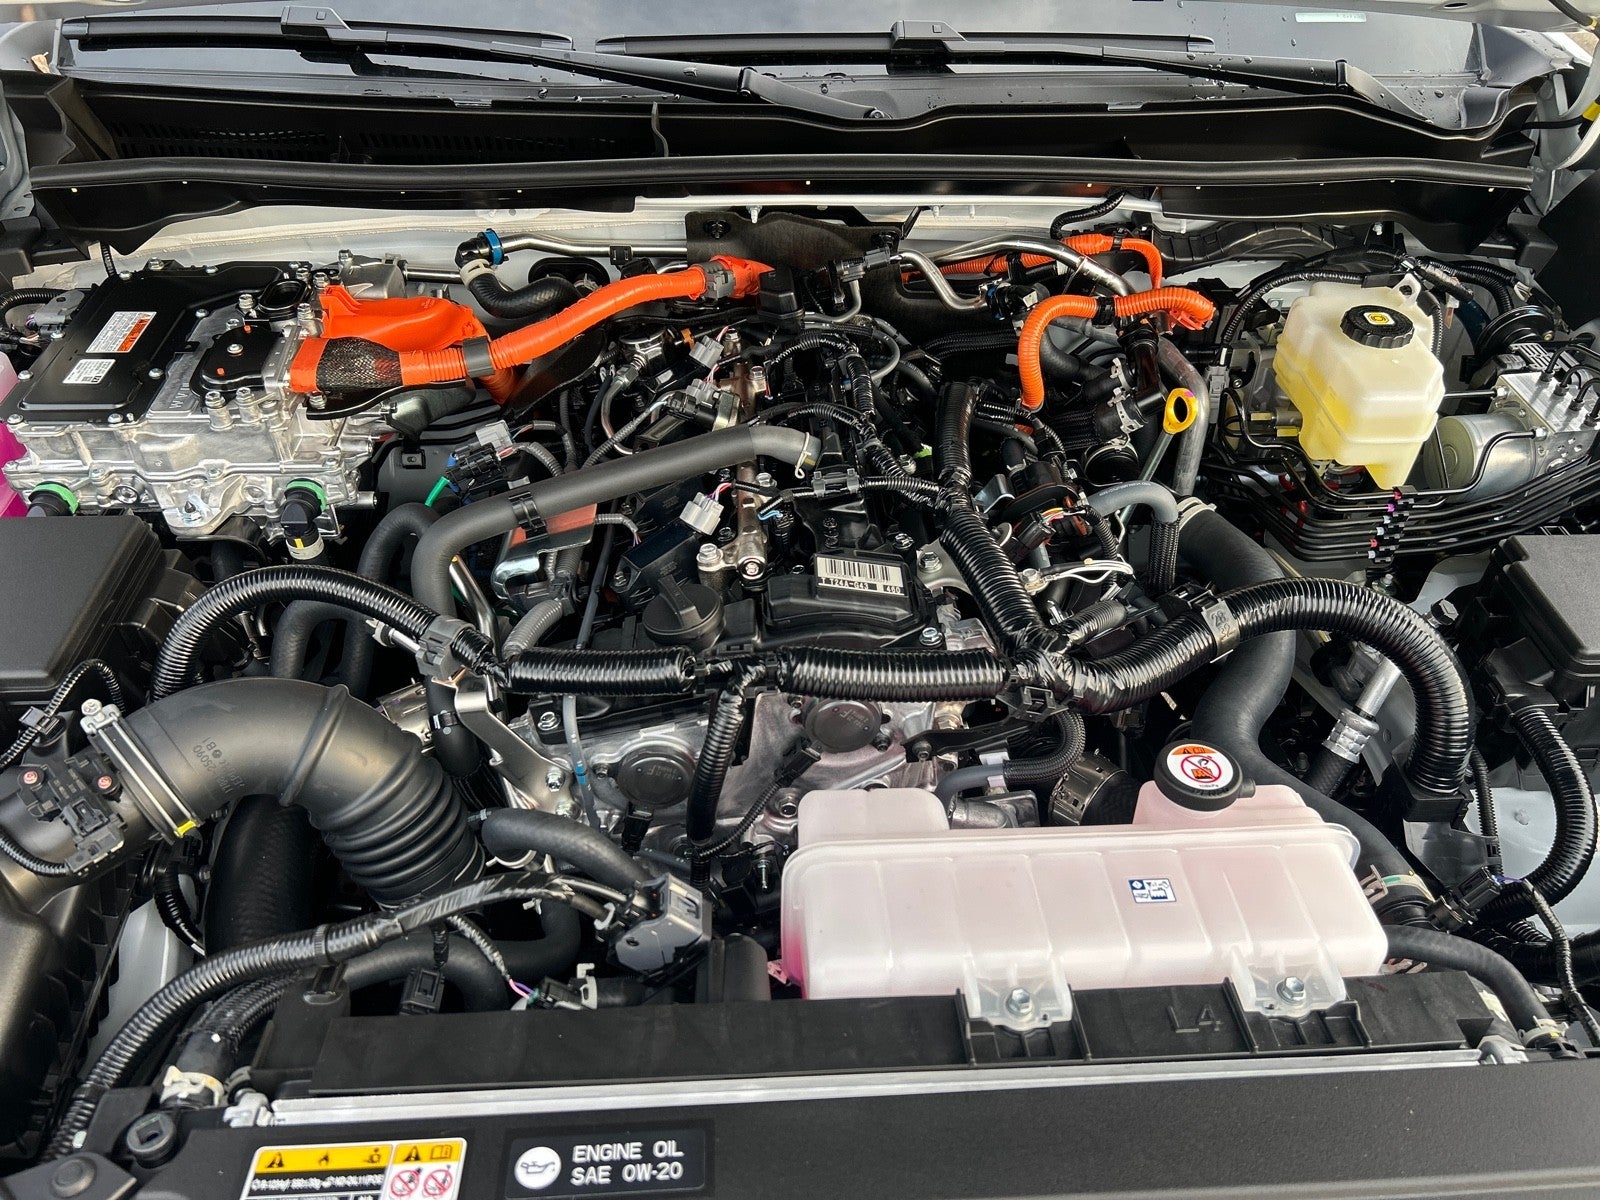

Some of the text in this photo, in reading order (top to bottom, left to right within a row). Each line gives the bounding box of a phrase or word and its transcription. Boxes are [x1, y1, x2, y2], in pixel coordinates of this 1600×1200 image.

[1211, 609, 1227, 627] 28
[1167, 1004, 1222, 1033] L4
[572, 1139, 685, 1164] ENGINE OIL
[570, 1161, 685, 1186] SAE 0W-20
